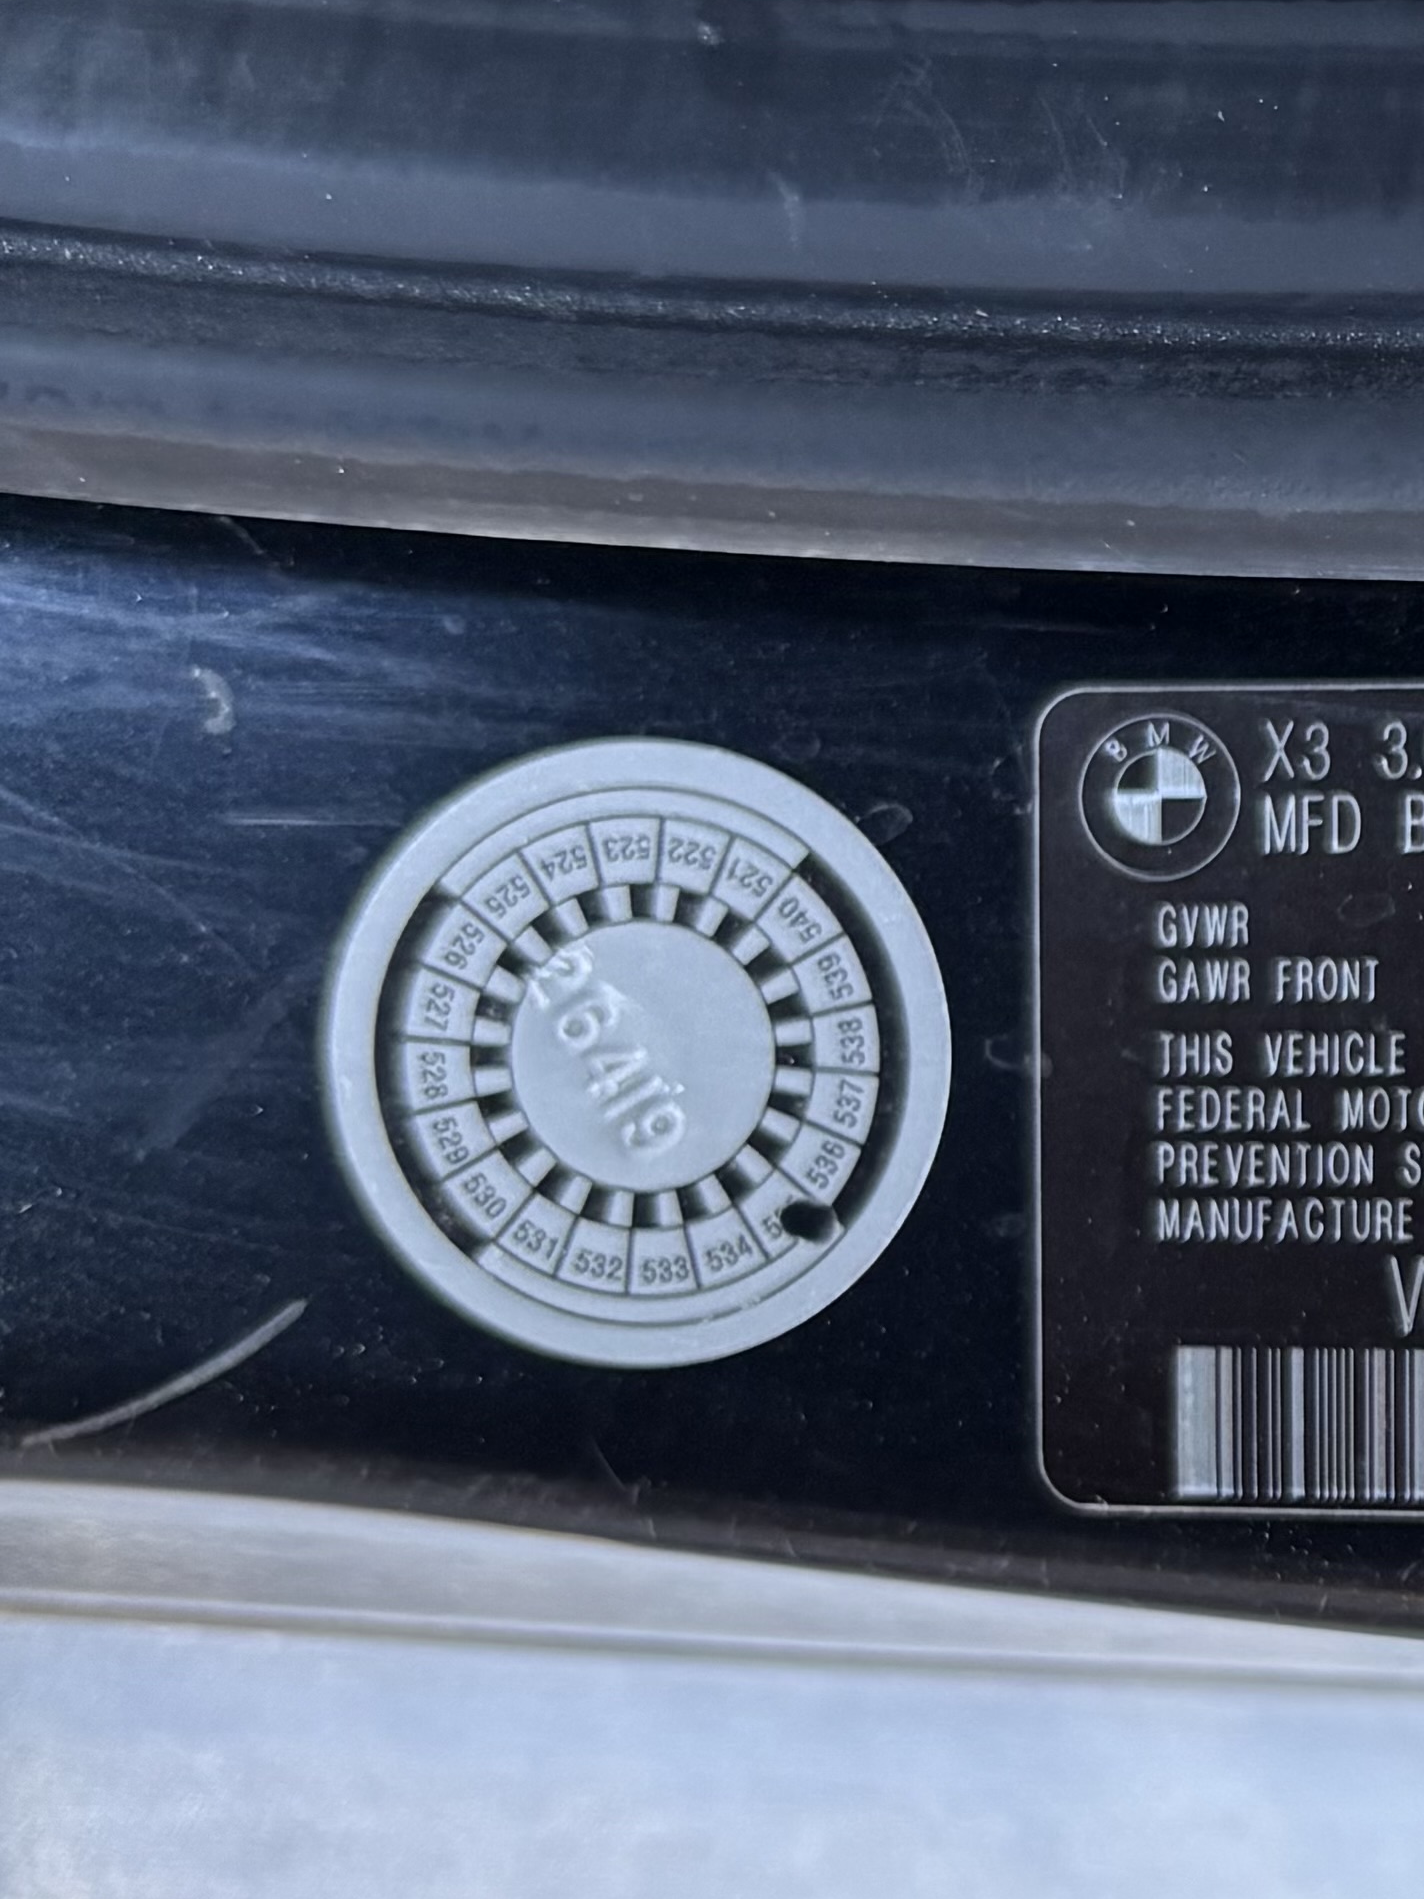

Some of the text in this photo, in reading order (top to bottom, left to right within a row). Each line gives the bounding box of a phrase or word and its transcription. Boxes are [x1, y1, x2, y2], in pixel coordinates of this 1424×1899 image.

[1104, 721, 1216, 765] BMW
[1263, 720, 1331, 782] X3
[1263, 794, 1361, 855] MFD
[539, 844, 589, 882] 524
[602, 834, 651, 862] 523
[669, 836, 718, 871] 522
[484, 873, 531, 917] 525
[726, 857, 775, 898] 521
[778, 896, 824, 943] 540
[1158, 904, 1249, 947] GVWR
[444, 922, 486, 970] 526
[818, 952, 854, 1001] 539
[1158, 959, 1250, 1002] GAWR
[1276, 958, 1379, 1002] FRONT
[426, 983, 456, 1032] 527
[837, 1016, 865, 1066] 538
[1160, 1031, 1233, 1076] THIS
[1264, 1032, 1405, 1076] VEHICLE
[420, 1051, 448, 1100] 528
[833, 1078, 866, 1131] 537
[1157, 1088, 1311, 1131] FEDERAL
[432, 1117, 470, 1165] 529
[806, 1140, 846, 1190] 536
[1157, 1142, 1374, 1186] PREVENTION
[462, 1172, 508, 1219] 530
[512, 1219, 560, 1260] 531
[1157, 1198, 1413, 1242] MANUFACTURE
[574, 1251, 624, 1281] 532
[640, 1255, 690, 1284] 533
[705, 1234, 754, 1274] 534
